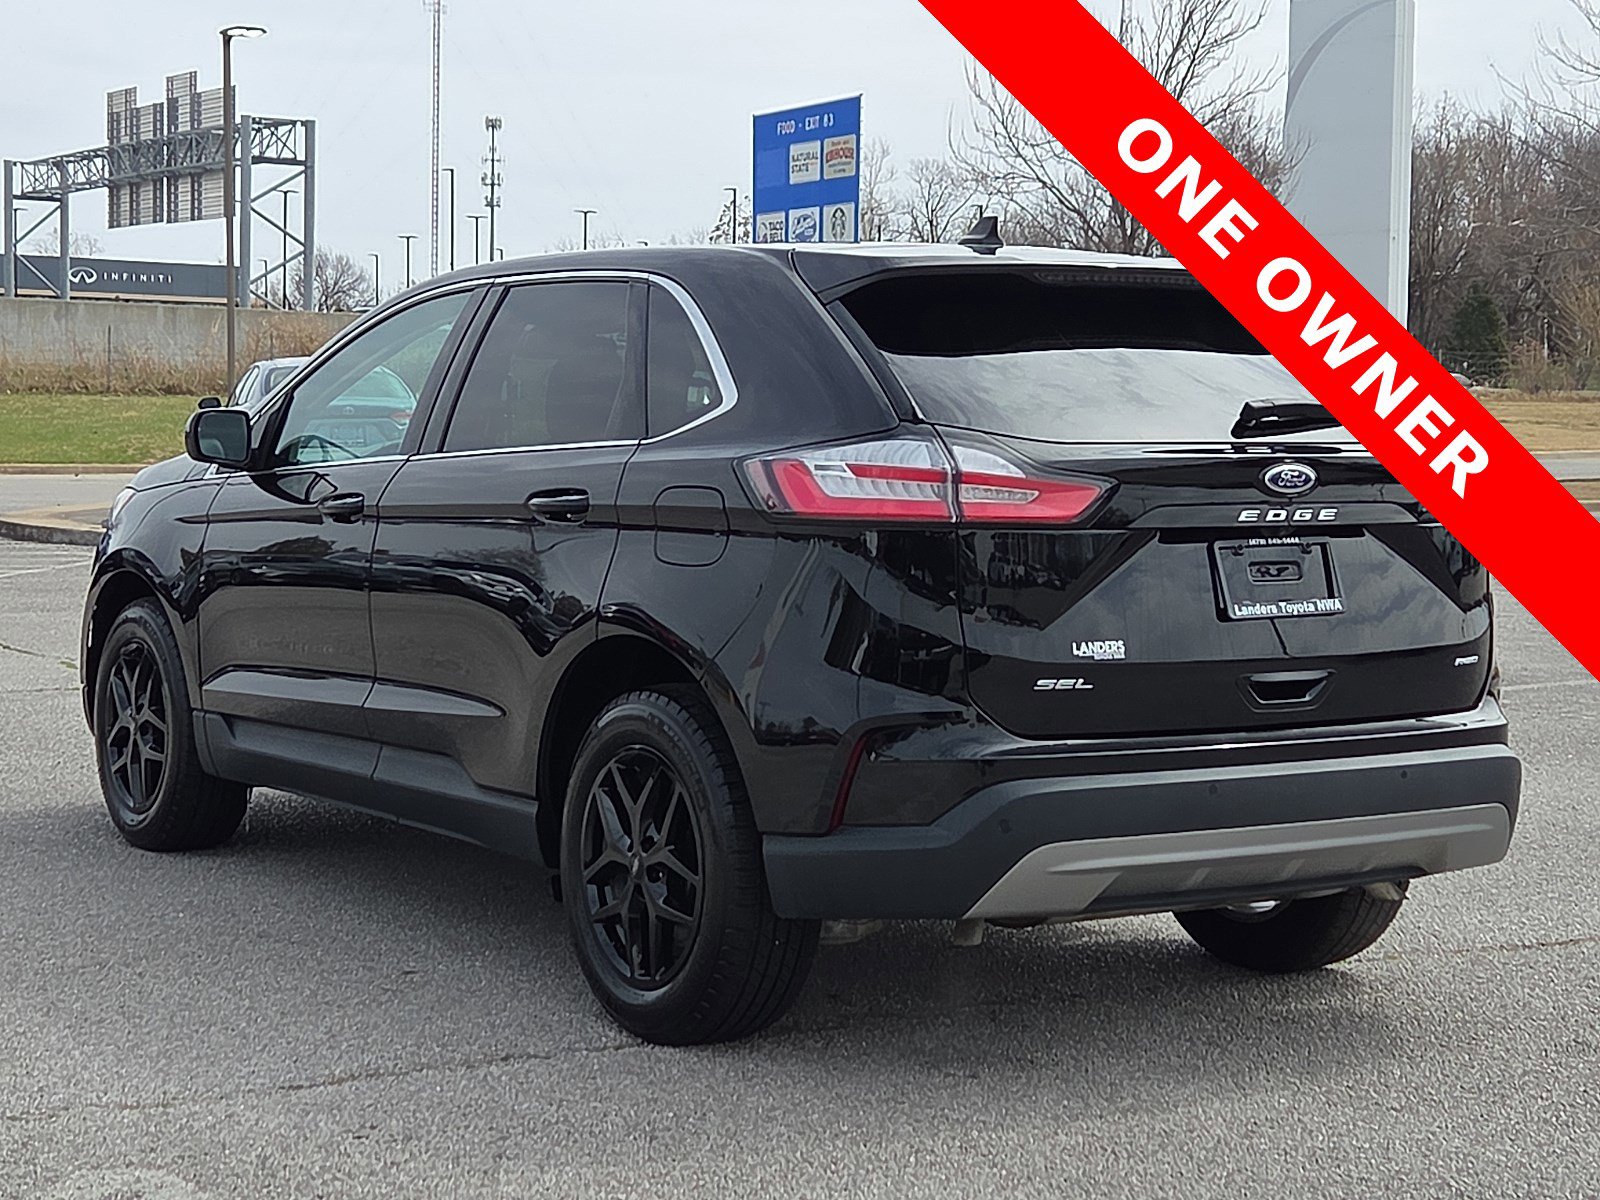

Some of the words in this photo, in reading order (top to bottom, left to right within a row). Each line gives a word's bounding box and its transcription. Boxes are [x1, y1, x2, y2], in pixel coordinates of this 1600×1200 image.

[777, 120, 796, 136] FOOD
[805, 115, 820, 131] EXIT
[791, 151, 819, 163] NATURAL
[791, 162, 809, 174] STATE
[768, 220, 784, 231] TACO
[102, 271, 172, 284] INFINITI
[1277, 470, 1306, 487] Ford
[1237, 508, 1339, 522] EDGE
[1233, 603, 1278, 616] Landers
[1278, 600, 1315, 616] Toyota
[1316, 598, 1343, 612] NWA
[1072, 640, 1125, 657] LANDERS
[1033, 678, 1094, 690] SEL
